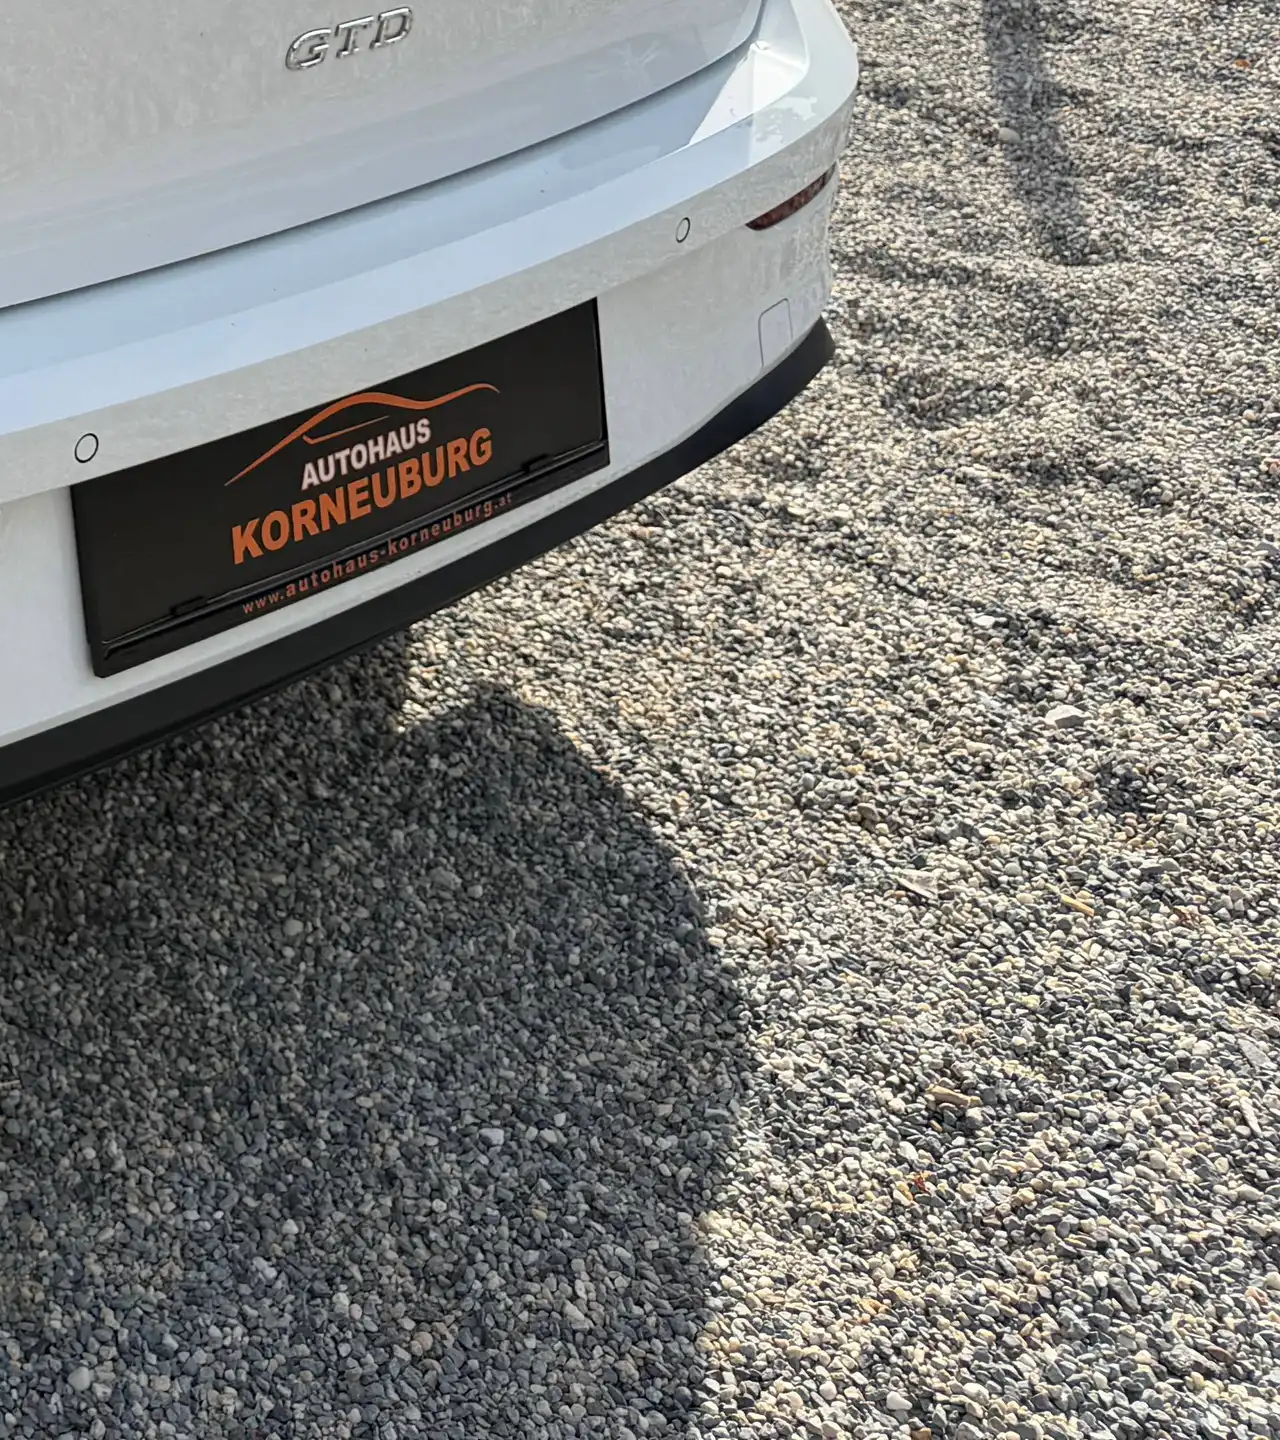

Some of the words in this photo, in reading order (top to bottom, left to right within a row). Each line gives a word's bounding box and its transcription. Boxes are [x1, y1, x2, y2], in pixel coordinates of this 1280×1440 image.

[286, 7, 413, 71] GTD
[231, 427, 493, 565] KORNEUBURG
[300, 418, 432, 491] AUTOHAUS
[242, 491, 513, 614] www.autohaus-korneuburg.at
